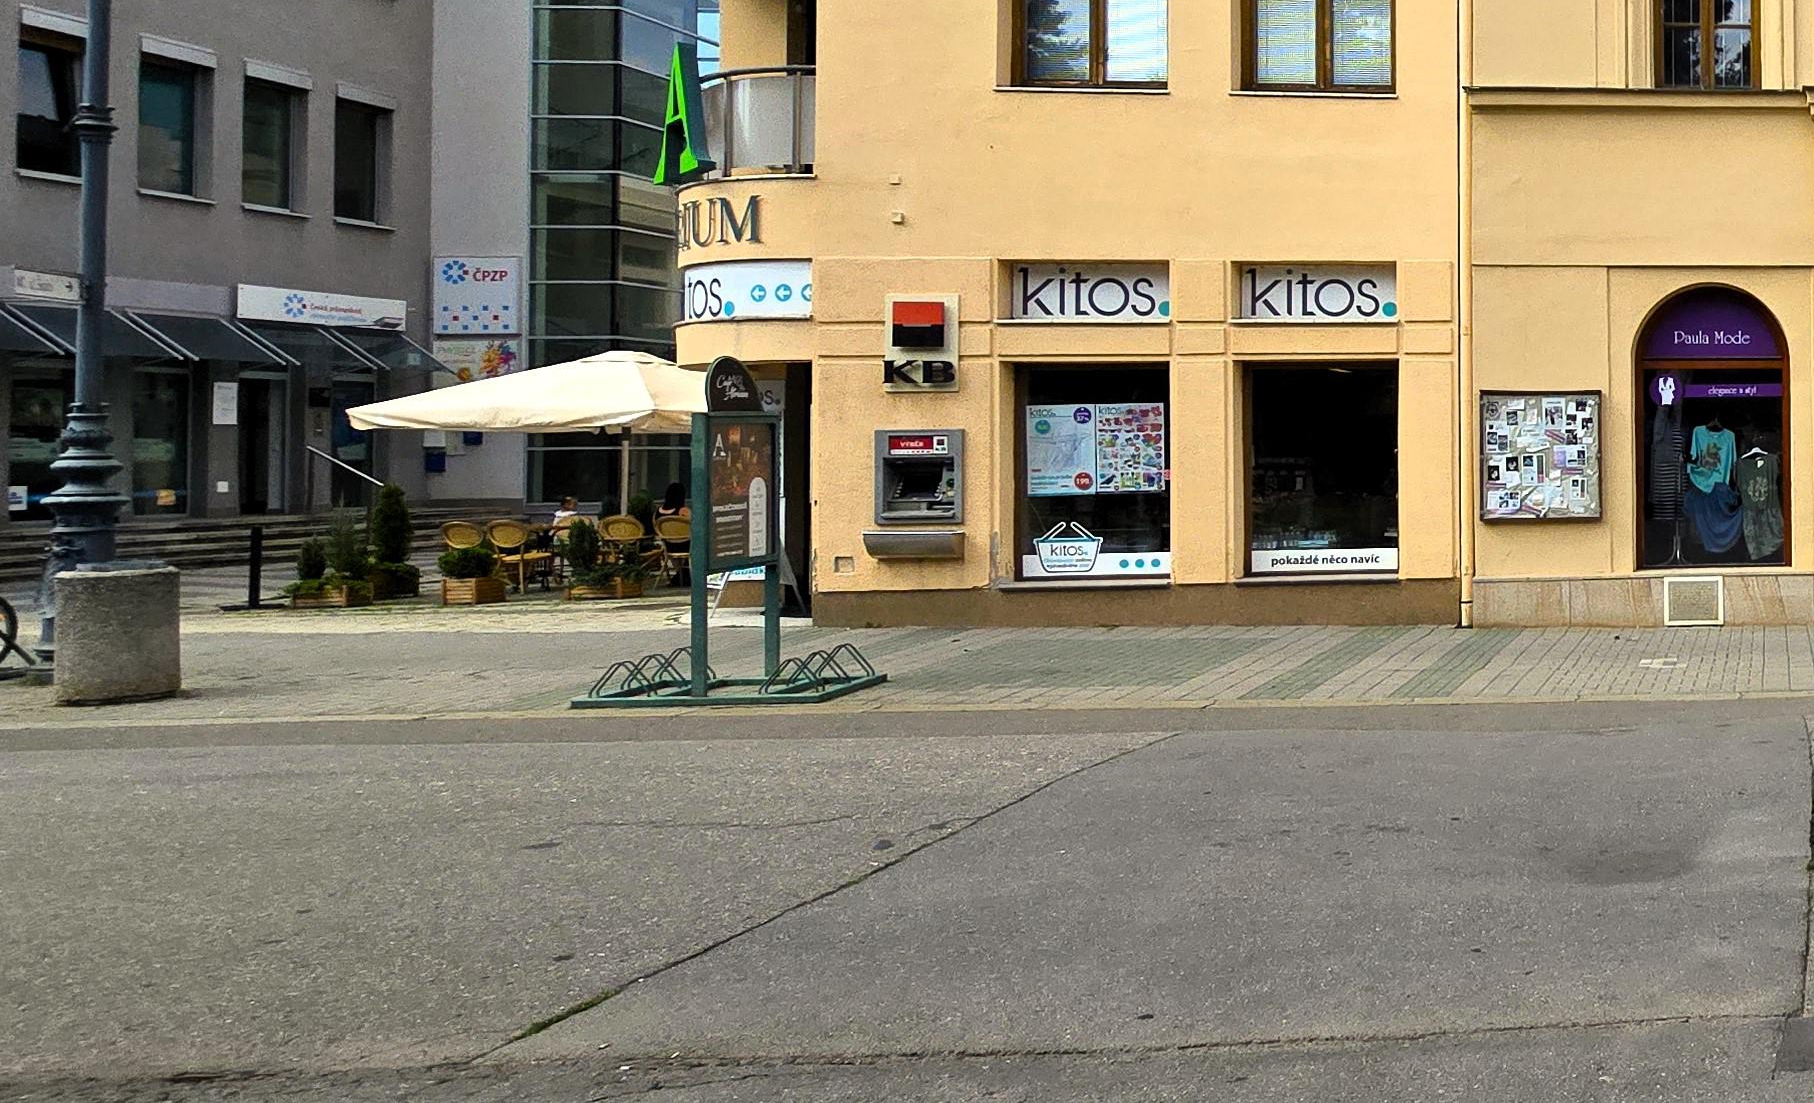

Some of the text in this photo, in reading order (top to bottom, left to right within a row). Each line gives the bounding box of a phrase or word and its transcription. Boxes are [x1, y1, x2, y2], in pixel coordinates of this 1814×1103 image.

[678, 195, 762, 251] IUM
[472, 267, 509, 282] ČPZP
[1674, 330, 1751, 345] Paula Mode
[882, 360, 955, 384] KB
[1271, 553, 1380, 567] pokaždé něco navíc
